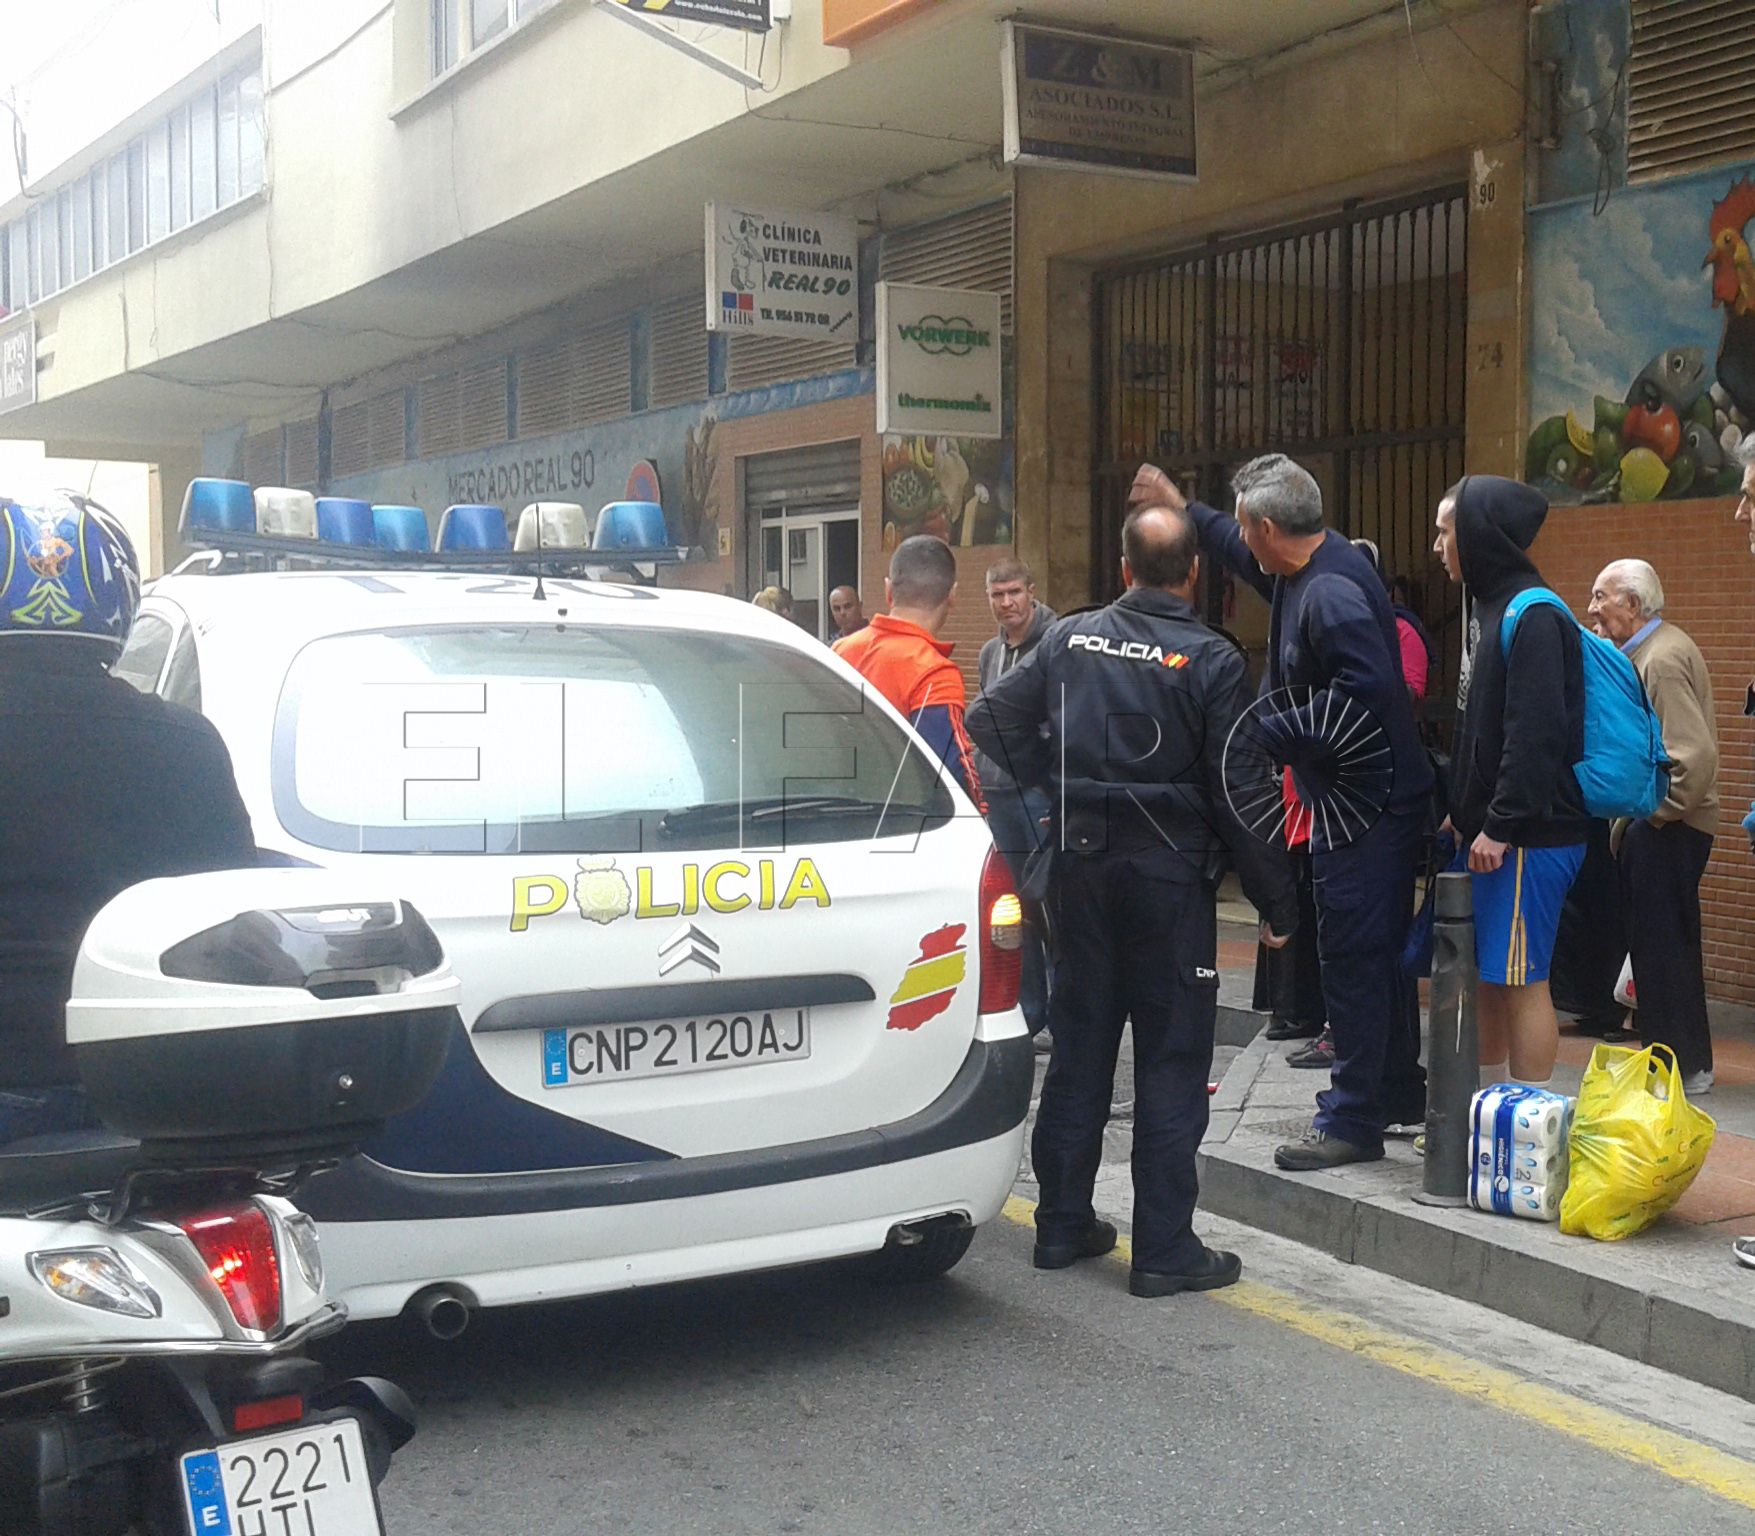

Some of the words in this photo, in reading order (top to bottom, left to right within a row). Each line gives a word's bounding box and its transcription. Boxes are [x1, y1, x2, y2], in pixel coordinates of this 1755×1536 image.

[1030, 87, 1144, 115] ASOCIADOS
[1480, 182, 1495, 204] 90
[762, 222, 822, 246] CLÍNICA
[763, 246, 853, 271] VETERINARIA
[898, 324, 991, 347] VORWERK
[898, 392, 992, 413] thermomix
[449, 462, 520, 505] MERCADO
[523, 454, 568, 496] REAL
[570, 448, 595, 489] 90
[1067, 634, 1163, 662] POLICIA
[1196, 967, 1216, 979] CNP
[551, 1062, 562, 1076] E
[230, 1433, 351, 1508] 2221
[202, 1505, 221, 1528] E
